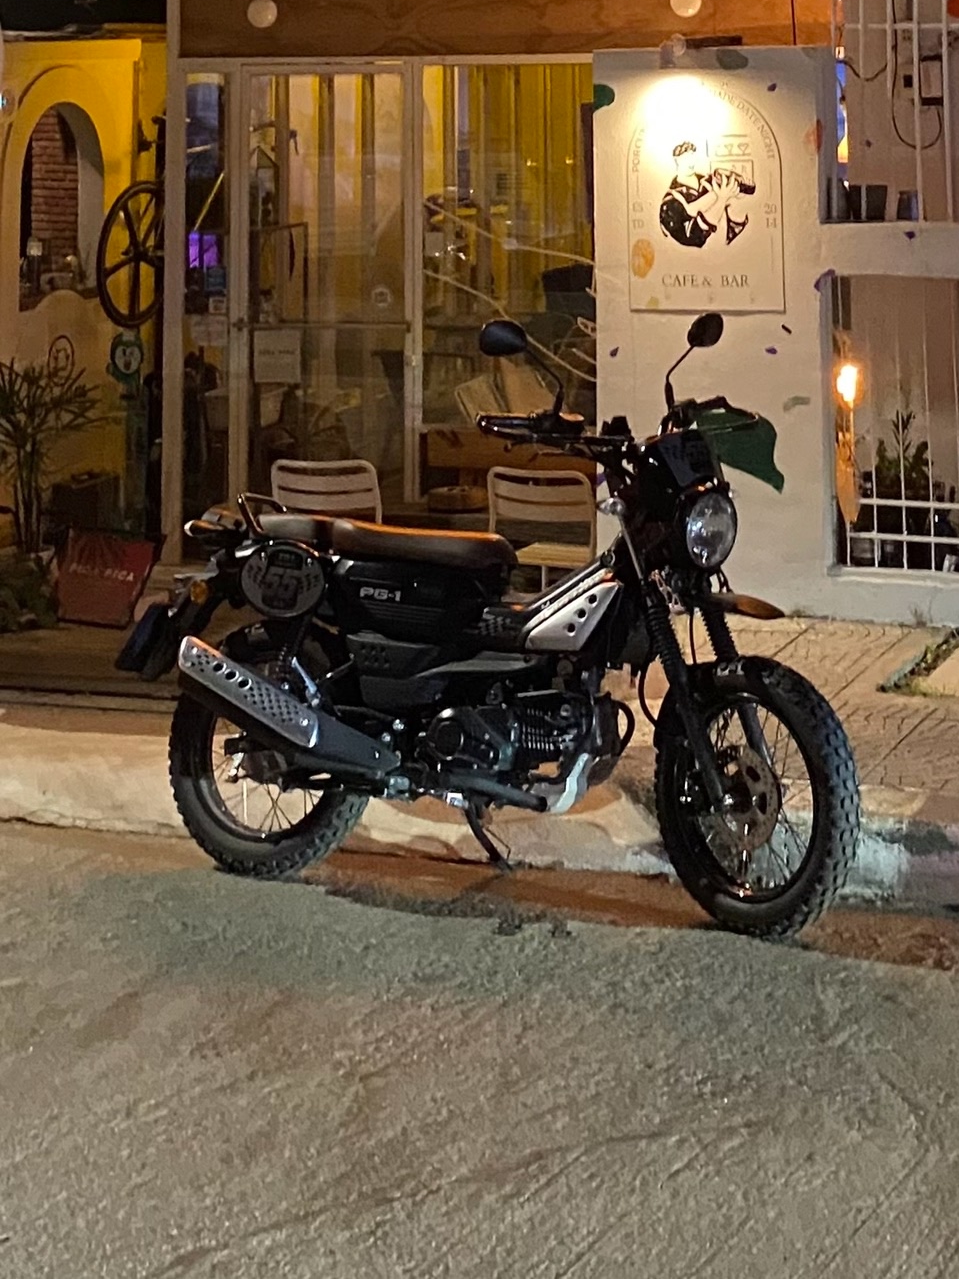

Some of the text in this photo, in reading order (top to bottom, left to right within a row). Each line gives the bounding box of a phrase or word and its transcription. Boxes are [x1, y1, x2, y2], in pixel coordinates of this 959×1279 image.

[661, 274, 749, 288] CAFE & BAR
[360, 586, 402, 602] PG-1
